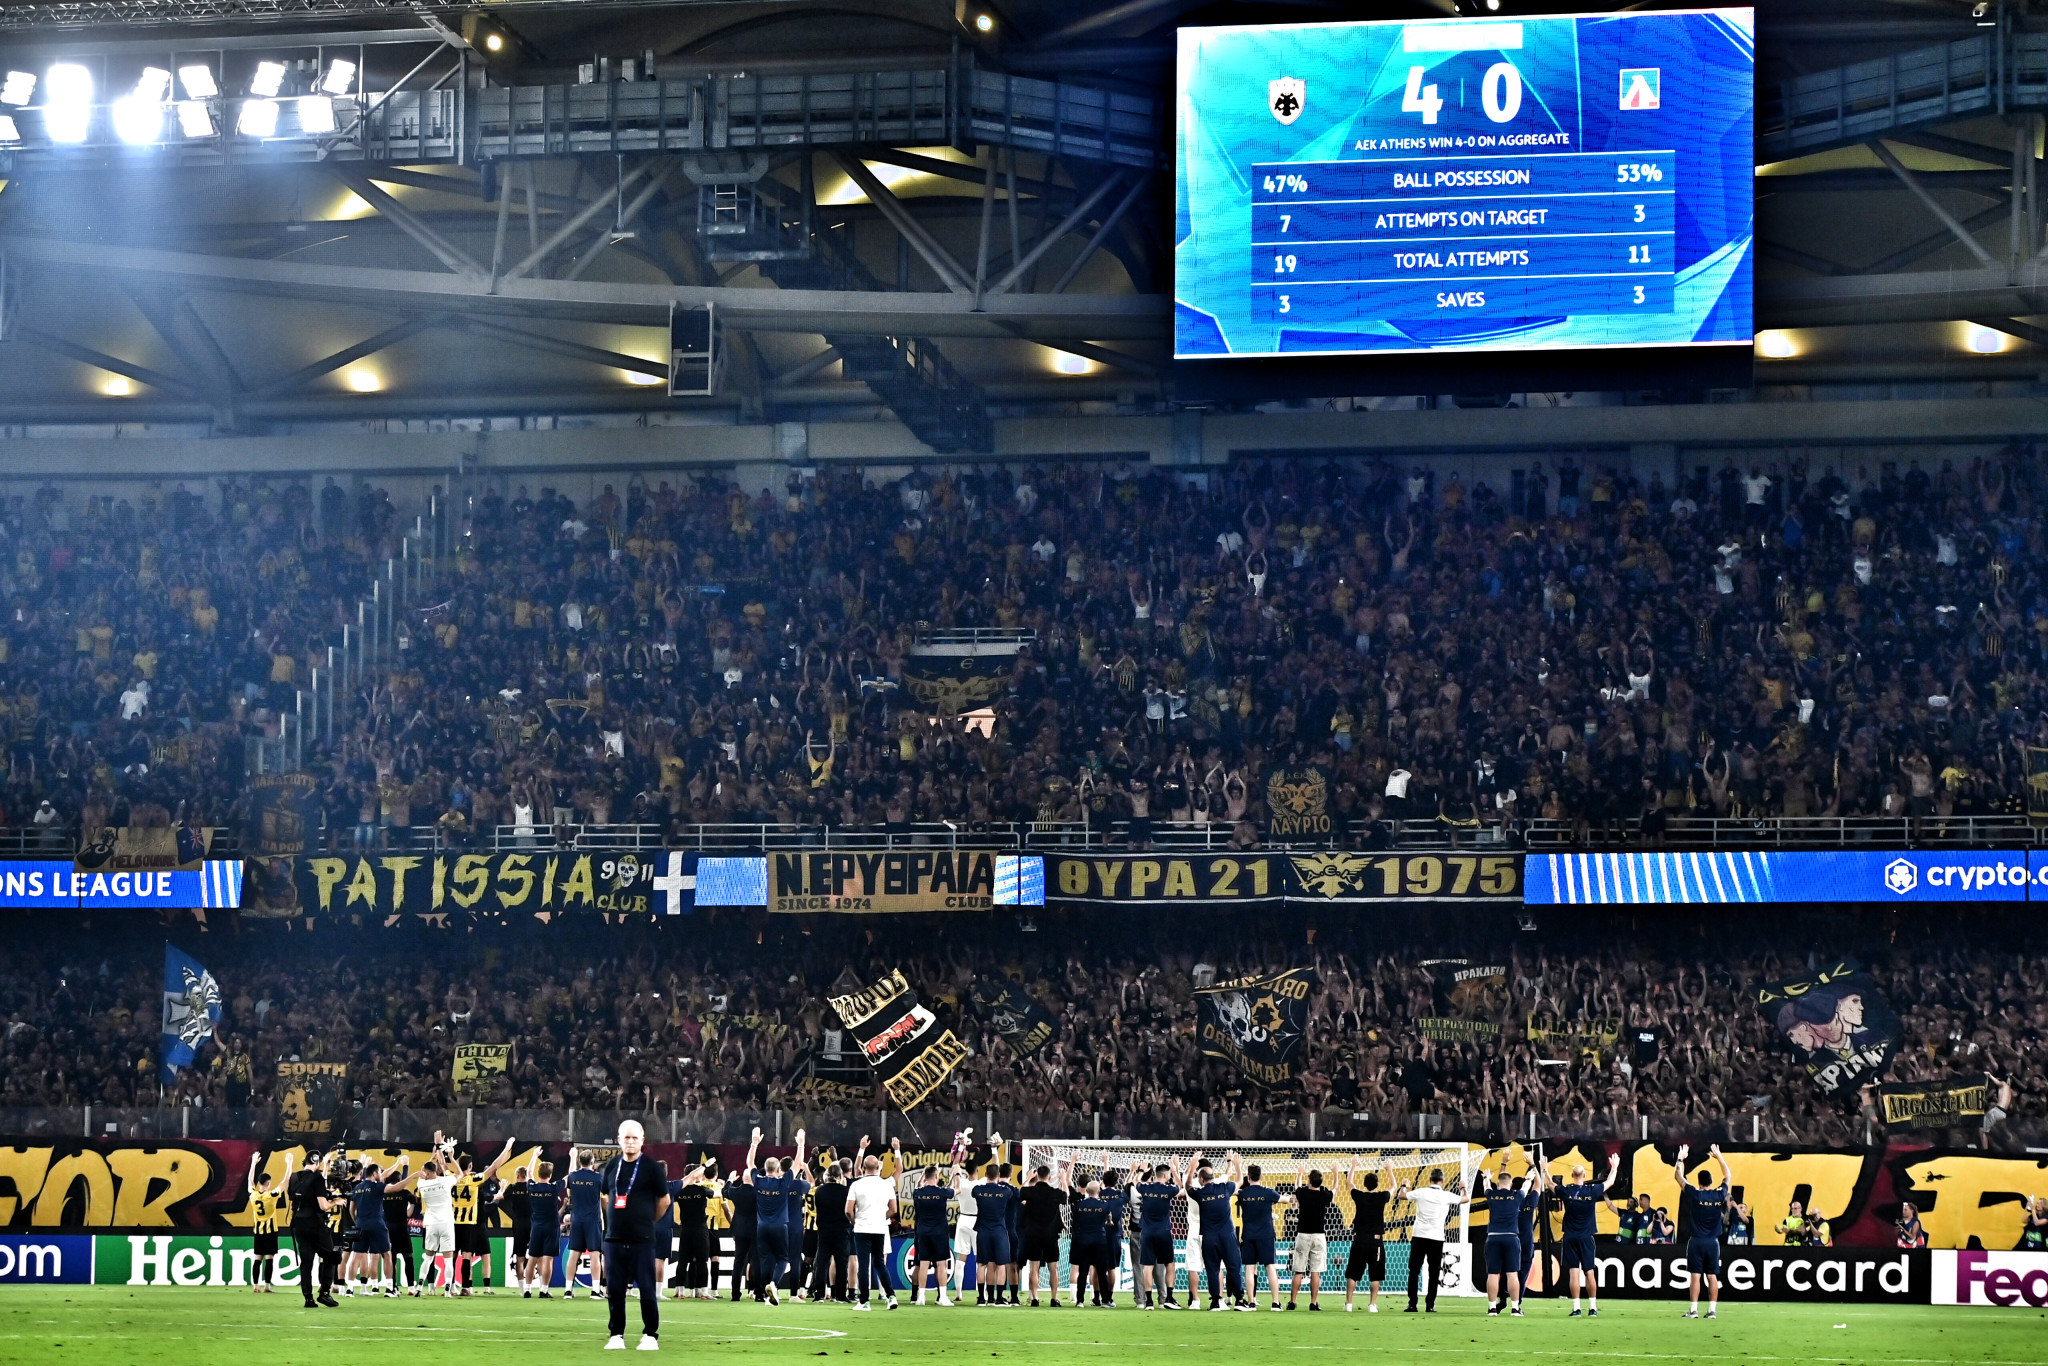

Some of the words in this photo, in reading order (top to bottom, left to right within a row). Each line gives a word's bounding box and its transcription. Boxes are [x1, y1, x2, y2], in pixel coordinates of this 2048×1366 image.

[1402, 66, 1443, 124] 4
[1482, 62, 1522, 123] 0
[1355, 139, 1377, 150] AEK
[1380, 137, 1426, 149] ATHENS
[1429, 136, 1453, 147] WIN
[1455, 136, 1475, 146] 4-0
[1478, 135, 1496, 146] ON
[1498, 133, 1570, 145] AGGREGATE
[1394, 172, 1432, 188] BALL
[1435, 169, 1530, 187] POSSESSION
[1617, 163, 1663, 182] 53%
[1263, 175, 1308, 193] 47%
[1375, 212, 1458, 228] ATTEMPTS
[1460, 211, 1485, 226] ON
[1487, 209, 1548, 225] TARGET
[1633, 204, 1646, 222] 3
[1280, 215, 1291, 232] 7
[1394, 252, 1443, 268] TOTAL
[1446, 250, 1529, 267] ATTEMPTS
[1628, 245, 1651, 263] 11
[1274, 255, 1297, 272] 19
[1436, 292, 1486, 307] SAVES
[1633, 285, 1646, 304] 3
[1279, 295, 1291, 313] 3
[1270, 815, 1331, 836] ΛΑΥΡΙΟ
[53, 871, 172, 896] LEAGUE
[304, 853, 596, 913] PATISSIA
[1209, 858, 1268, 896] 21
[1373, 856, 1517, 895] 1975
[597, 892, 648, 912] CLUB
[777, 897, 830, 911] SINCE
[834, 896, 871, 911] 1974
[944, 896, 992, 909] CLUB
[1422, 1030, 1476, 1042] ORIGINA
[457, 1046, 510, 1059] THIVA
[277, 1063, 347, 1077] SOUTH
[1889, 1096, 1941, 1120] ARGOS
[1945, 1088, 1986, 1112] CLUB
[283, 1119, 332, 1133] SIDE
[902, 1149, 954, 1171] Origina
[451, 1185, 472, 1202] 44
[255, 1200, 266, 1216] 3
